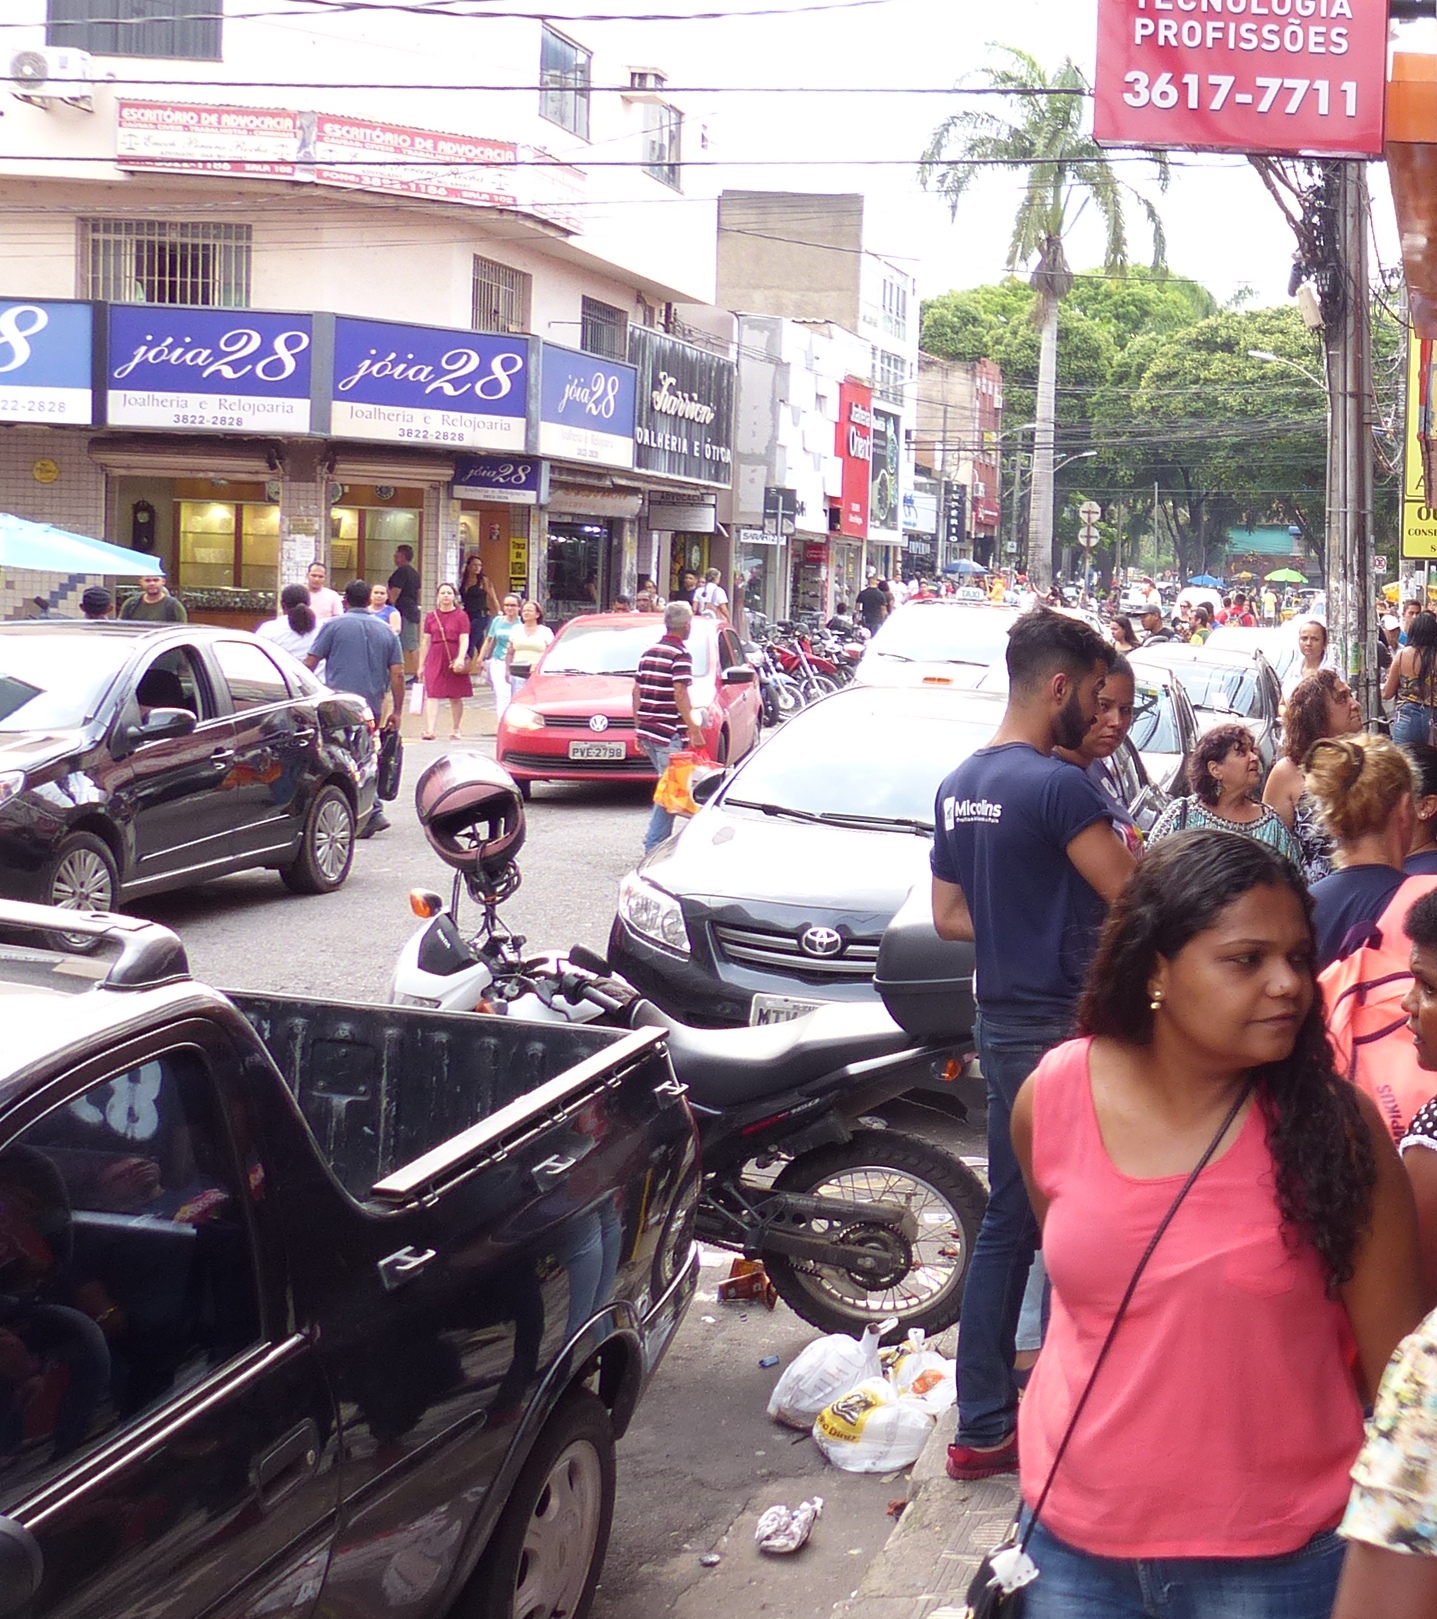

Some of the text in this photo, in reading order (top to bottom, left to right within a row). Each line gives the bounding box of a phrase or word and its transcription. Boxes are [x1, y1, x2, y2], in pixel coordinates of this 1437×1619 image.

[1134, 18, 1349, 54] PROFISSÕES
[1123, 71, 1358, 117] 3617-7711
[122, 107, 294, 131] ESCRITÓRIO DE ADVOCACIA
[323, 122, 515, 162] ESCRITÓRIO DE ADVOCACIA
[122, 393, 295, 415] Joalheria e Relojoaria
[173, 414, 244, 428] 3822-2828
[350, 404, 512, 432] Joalheria e Relojoaria
[398, 427, 465, 442] 3822-2828
[636, 426, 733, 464] OALHERIA E ÓTICA
[961, 589, 981, 598] TAXI
